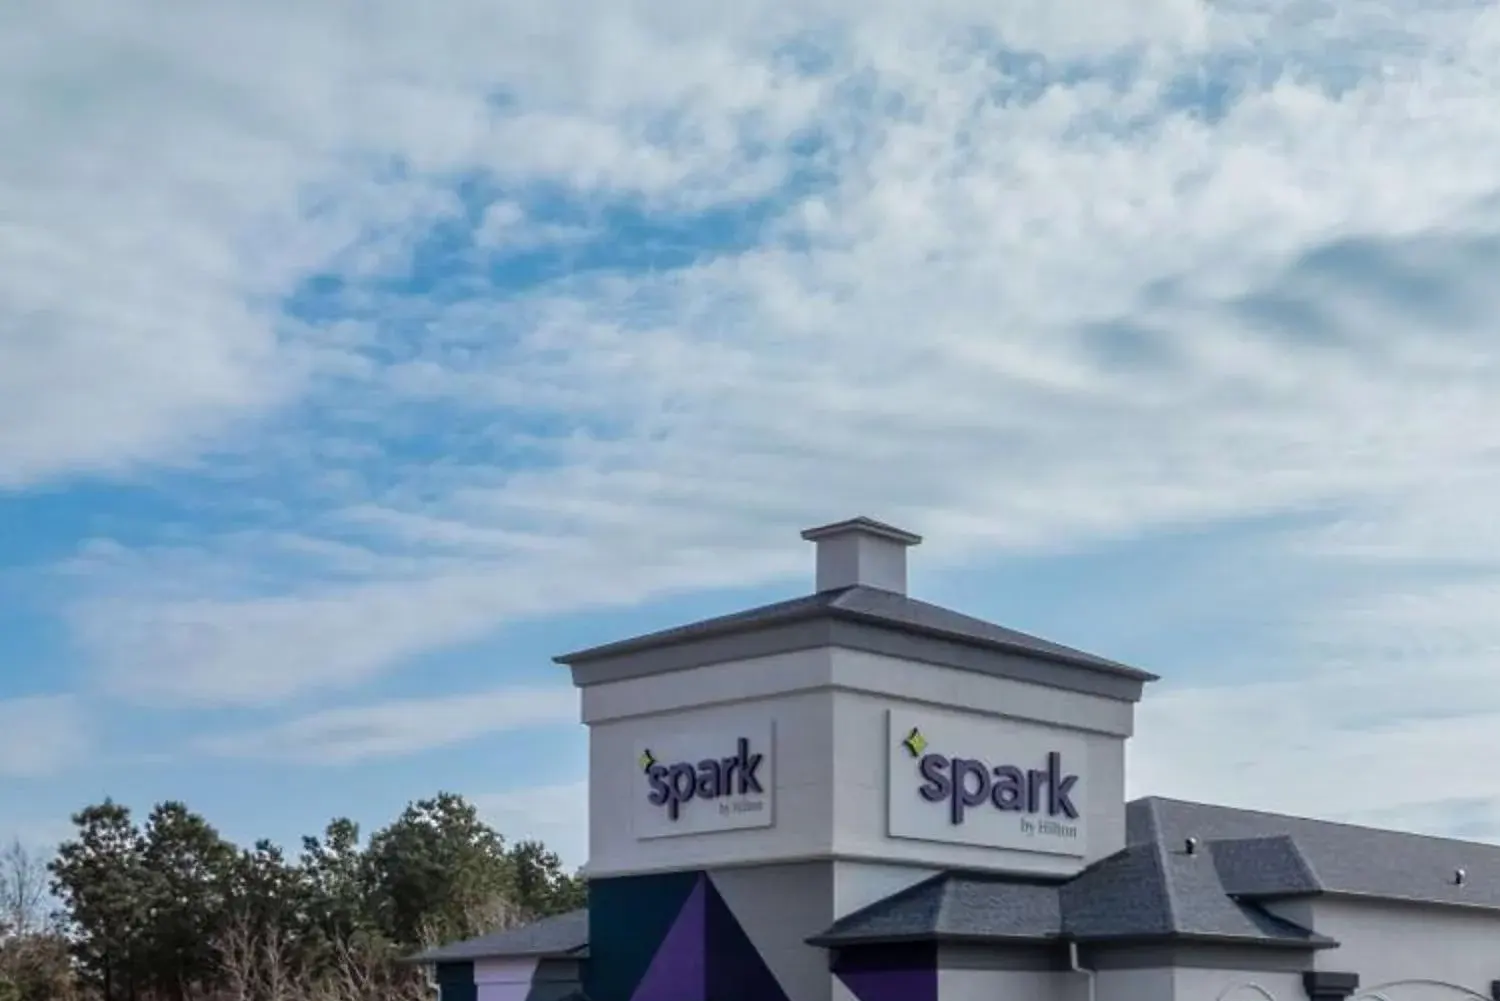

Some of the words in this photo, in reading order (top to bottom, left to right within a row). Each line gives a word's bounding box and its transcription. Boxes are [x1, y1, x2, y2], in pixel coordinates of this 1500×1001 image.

[647, 737, 763, 821] spark
[919, 751, 1080, 826] spark
[1020, 817, 1035, 837] by
